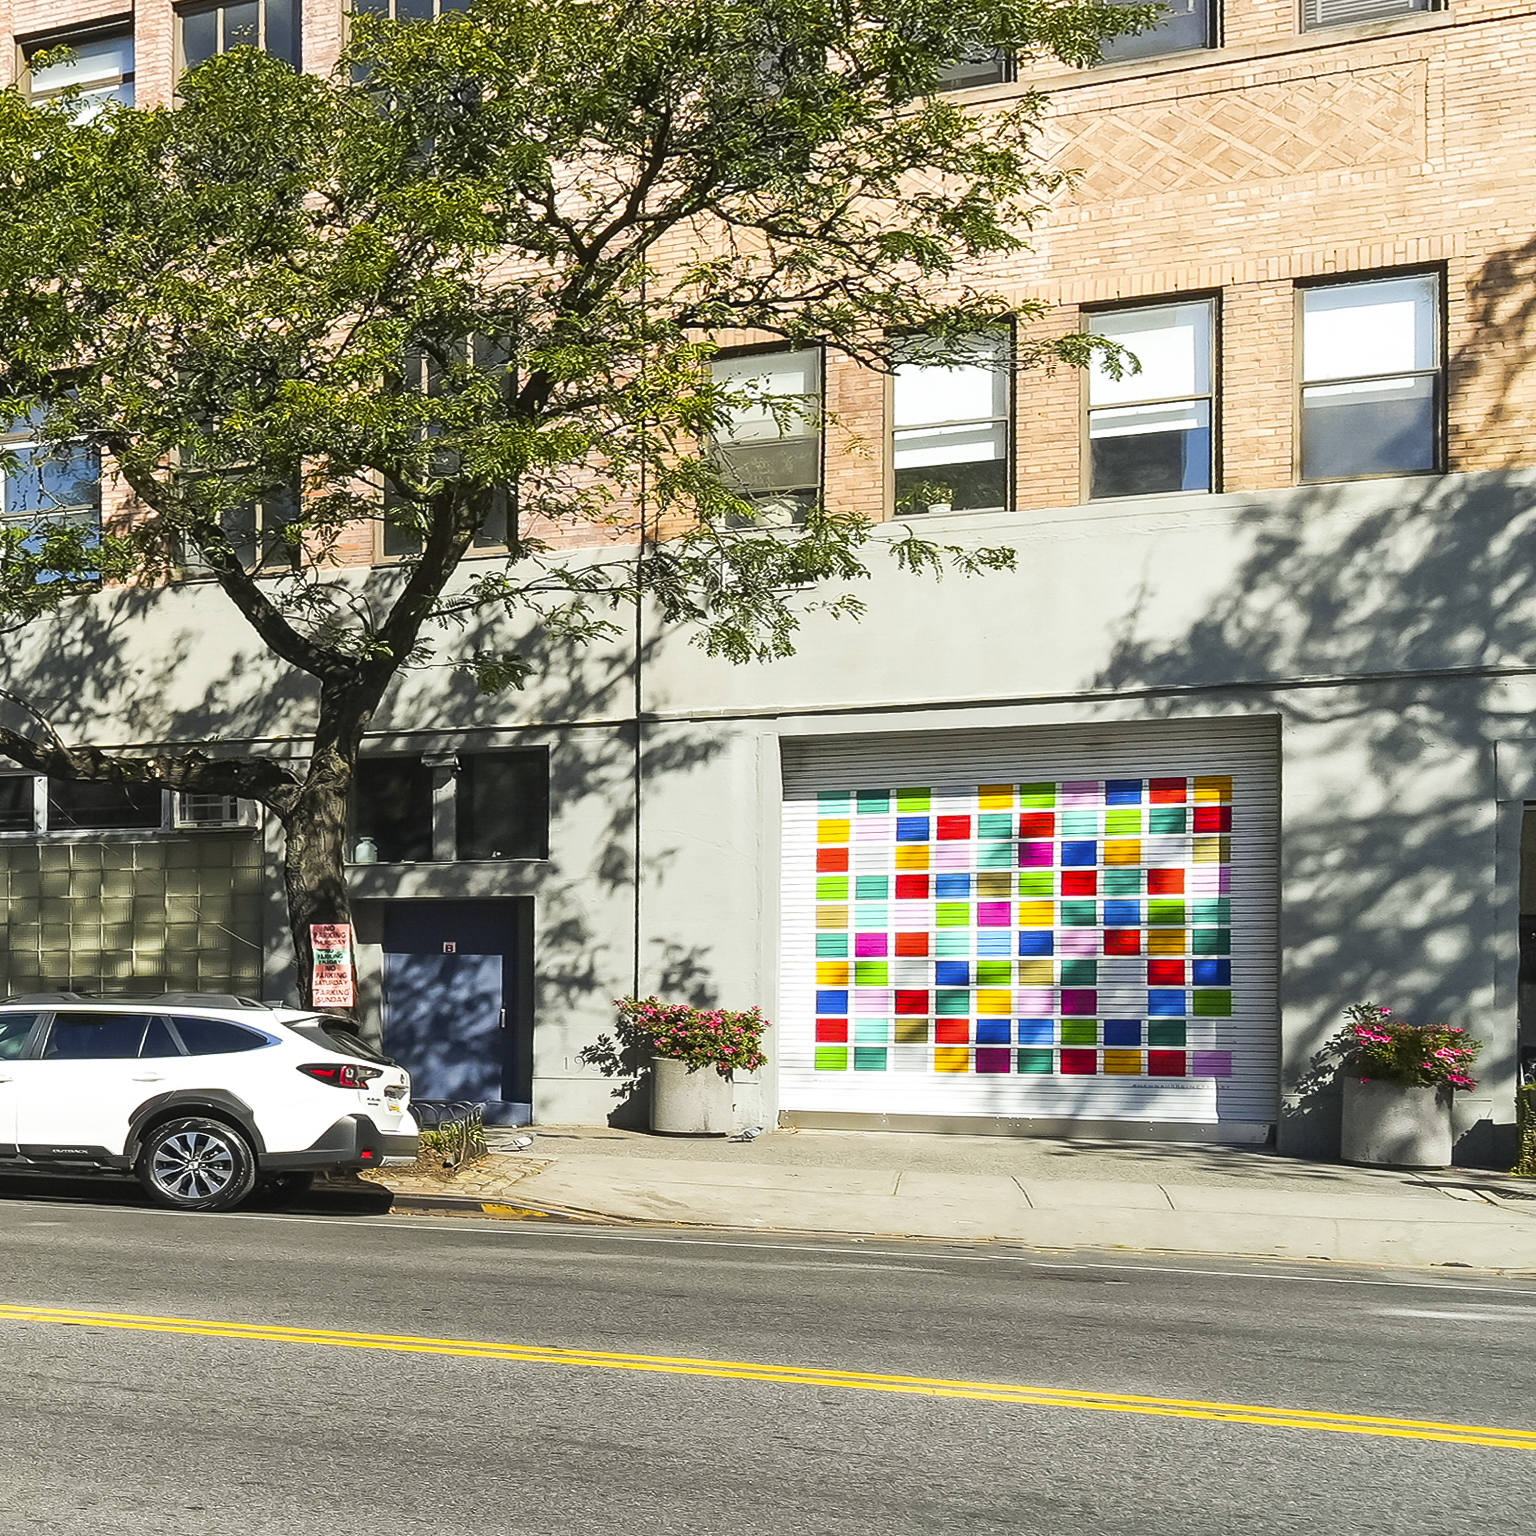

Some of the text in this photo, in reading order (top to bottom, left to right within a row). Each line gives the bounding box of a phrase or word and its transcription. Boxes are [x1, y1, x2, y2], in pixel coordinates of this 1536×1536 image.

[313, 931, 347, 939] PARKING
[445, 944, 454, 953] B
[324, 964, 337, 972] NO
[315, 971, 348, 979] PARKING
[315, 988, 350, 996] PARKING
[315, 996, 349, 1004] SUNDAY
